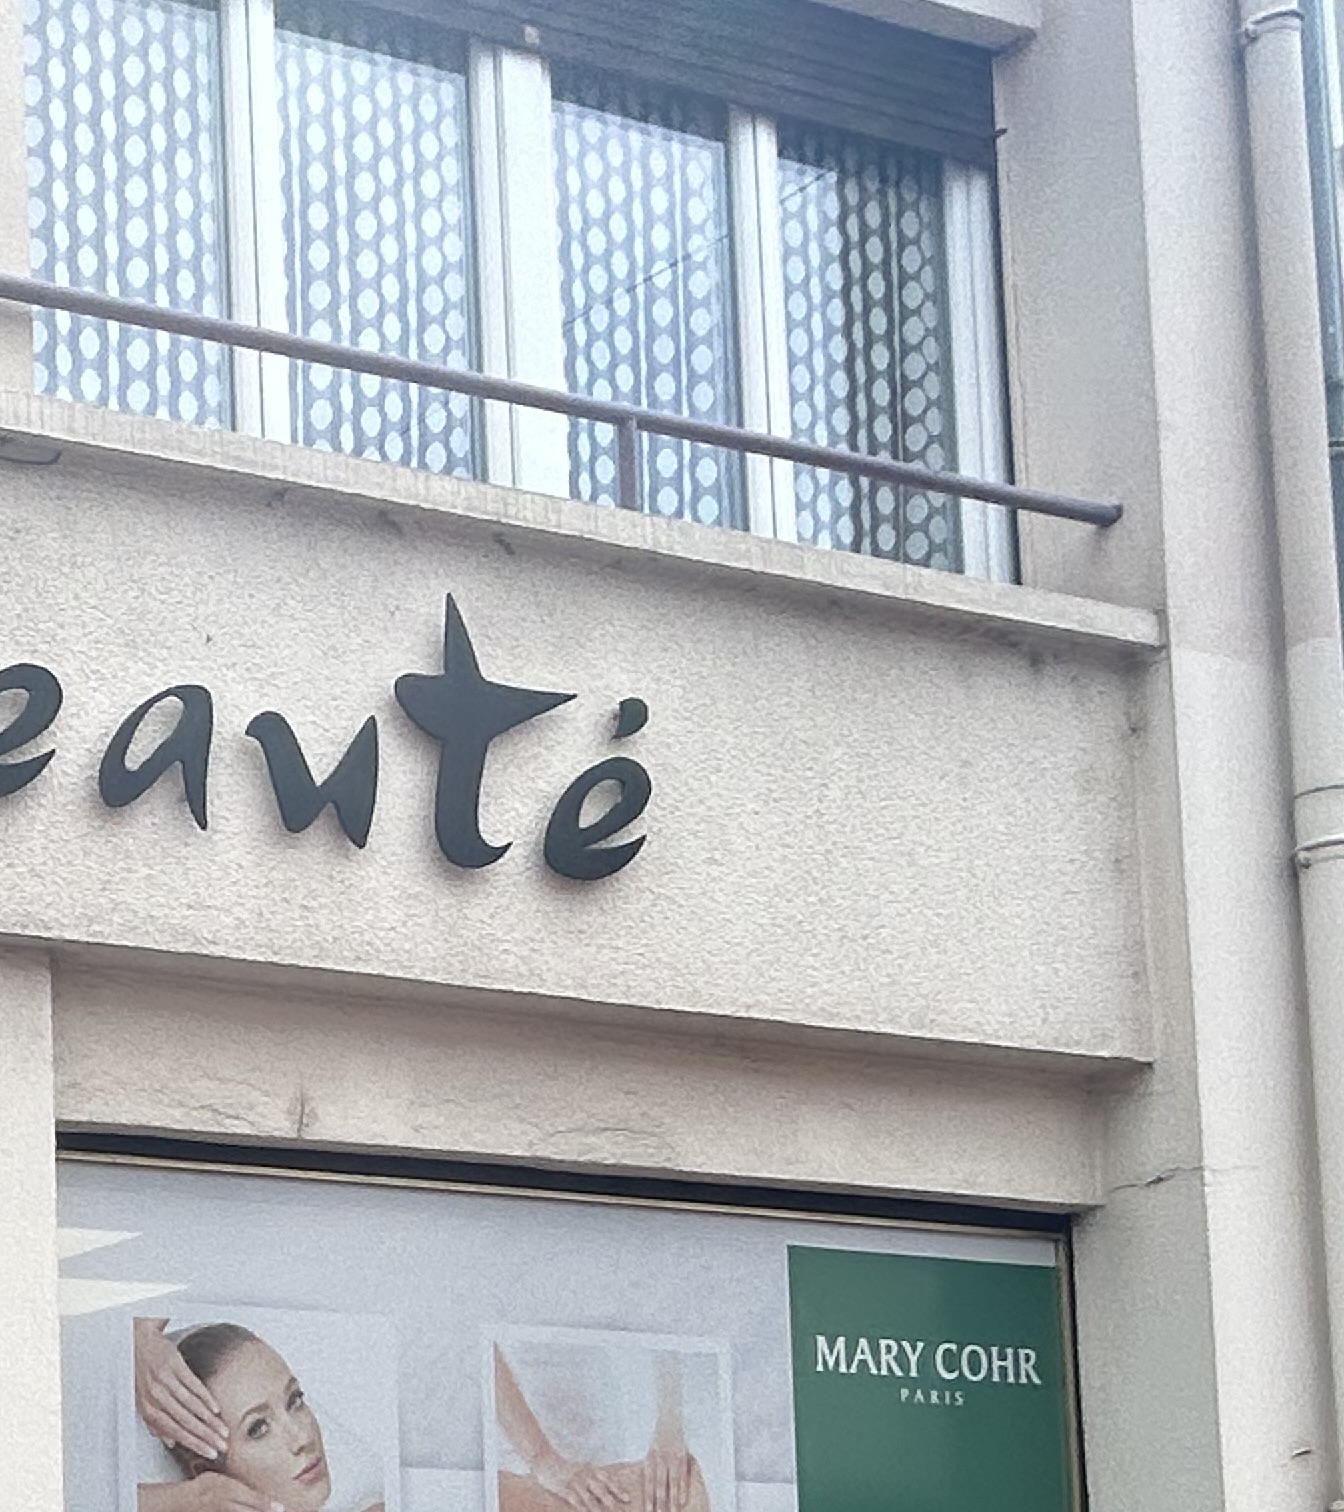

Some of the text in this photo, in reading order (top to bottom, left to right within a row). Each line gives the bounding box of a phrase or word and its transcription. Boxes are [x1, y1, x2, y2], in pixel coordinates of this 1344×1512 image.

[815, 1335, 1042, 1385] MARY COHR
[900, 1388, 964, 1406] PARIS
